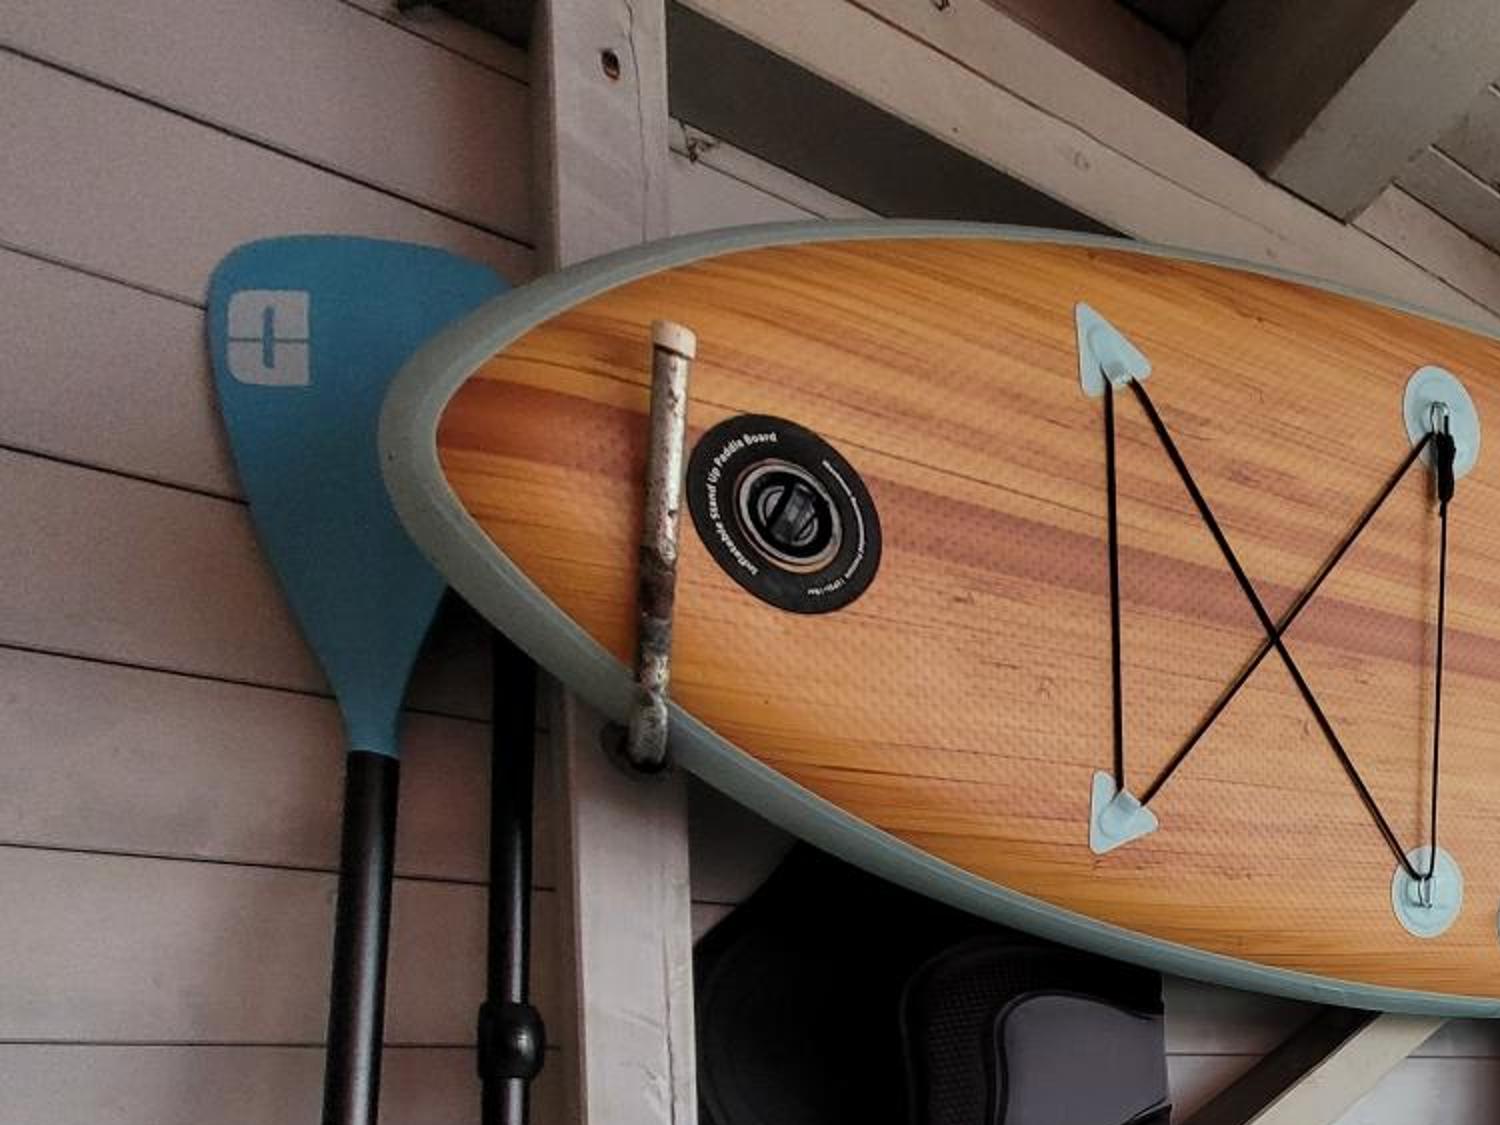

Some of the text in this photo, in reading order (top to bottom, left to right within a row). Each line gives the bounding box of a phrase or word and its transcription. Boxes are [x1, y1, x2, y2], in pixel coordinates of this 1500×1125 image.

[705, 431, 777, 576] Inflatable Stand Up Paddle Board
